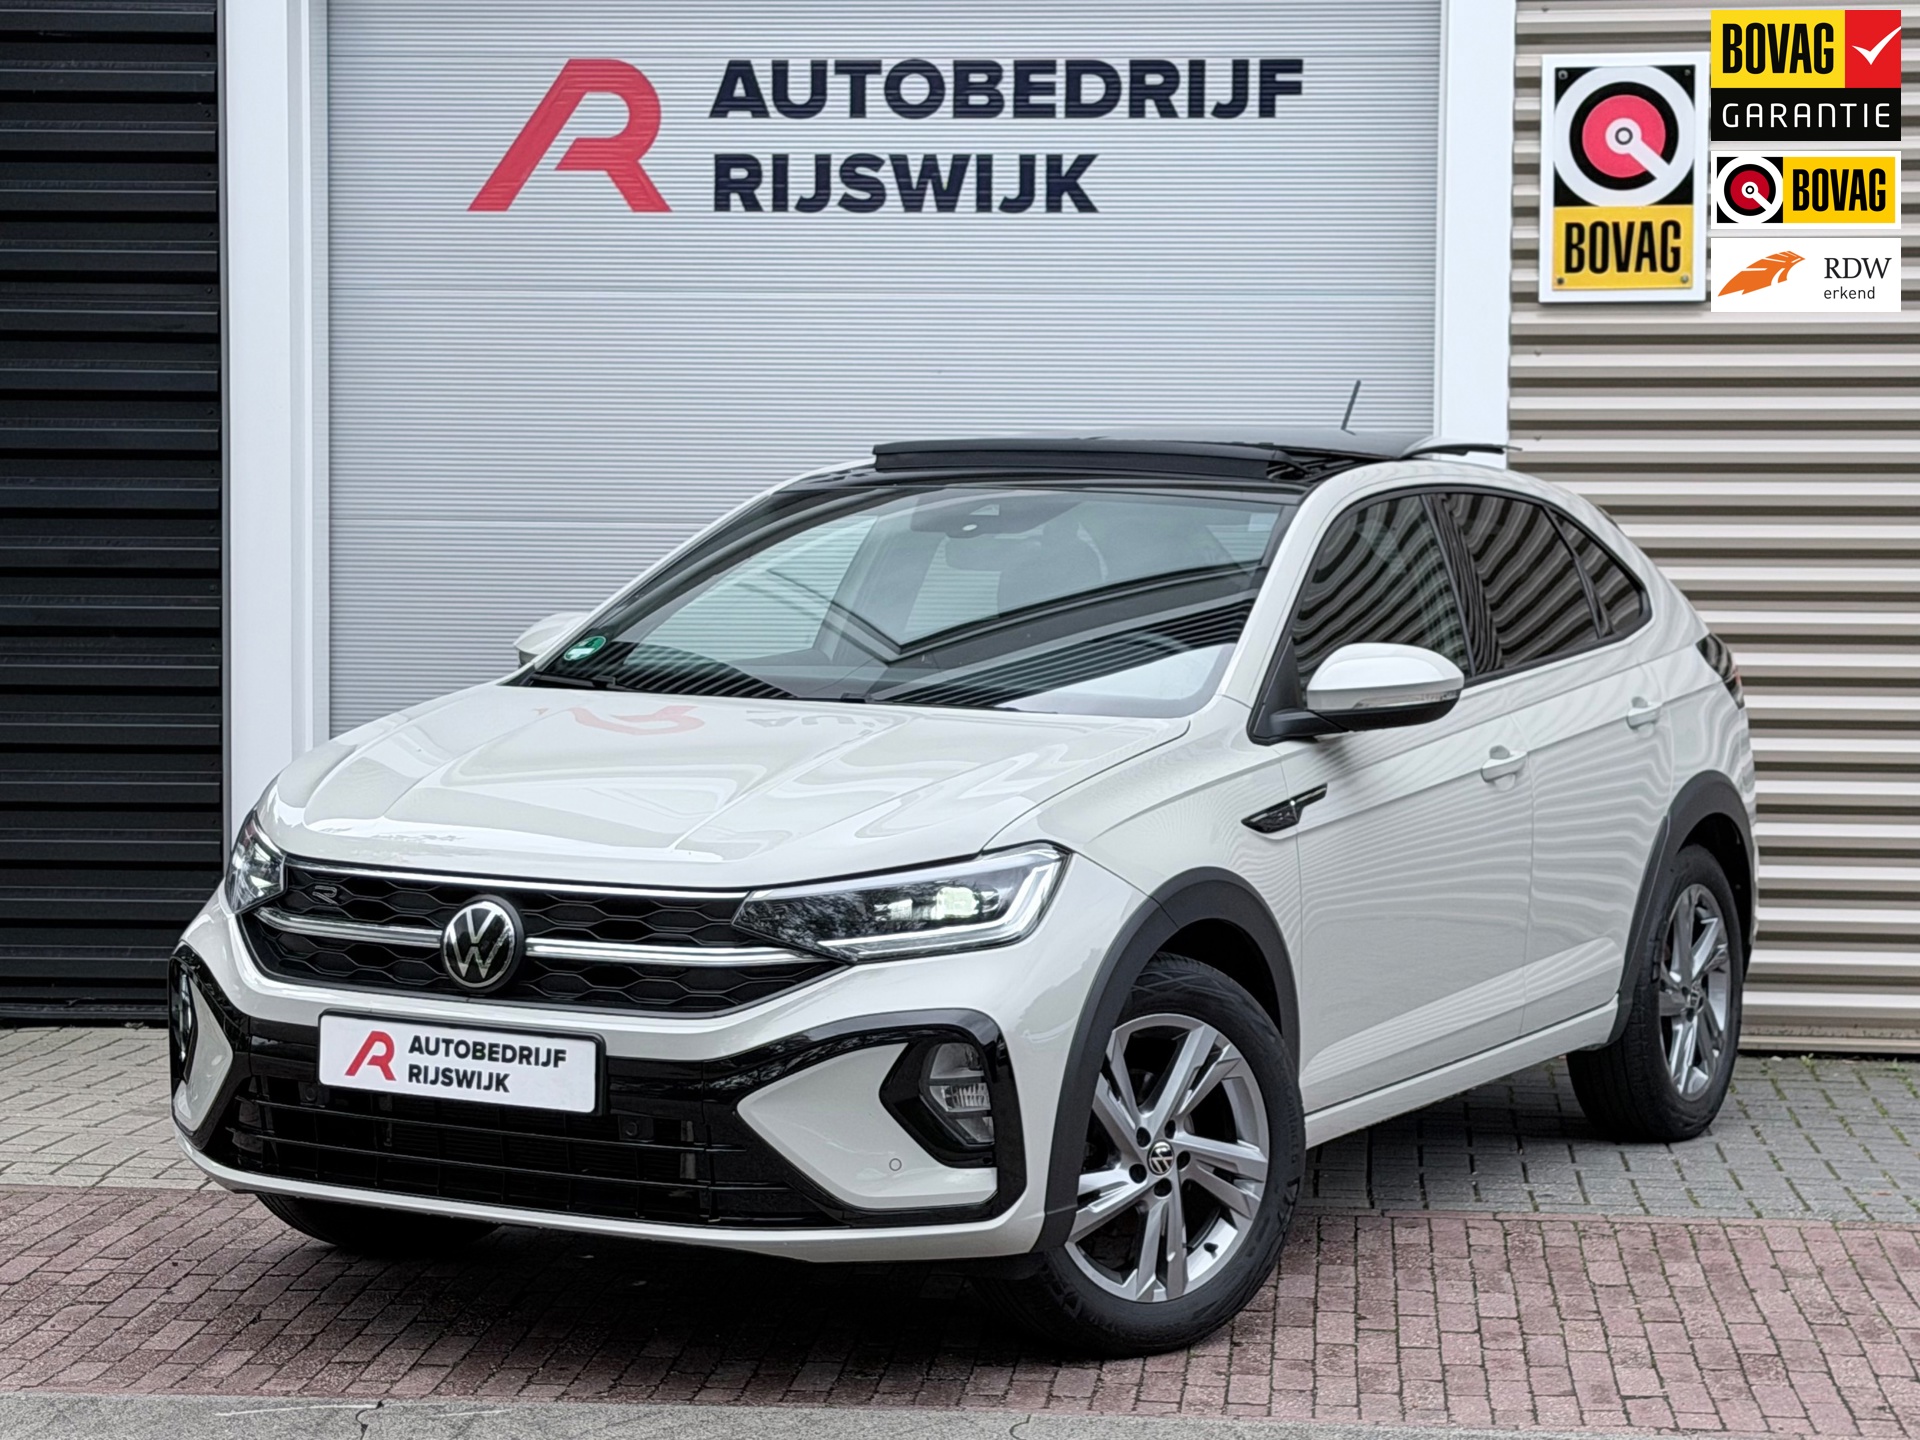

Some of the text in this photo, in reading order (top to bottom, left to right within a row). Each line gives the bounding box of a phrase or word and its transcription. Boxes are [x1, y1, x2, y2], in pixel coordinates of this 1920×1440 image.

[709, 58, 1304, 119] AUTOBEDRIJF
[712, 153, 1100, 214] RIJSWIJK
[1564, 219, 1682, 275] BOVAG
[407, 1034, 568, 1069] AUTOBEDRIJF
[407, 1063, 511, 1094] RIJSWIJK
